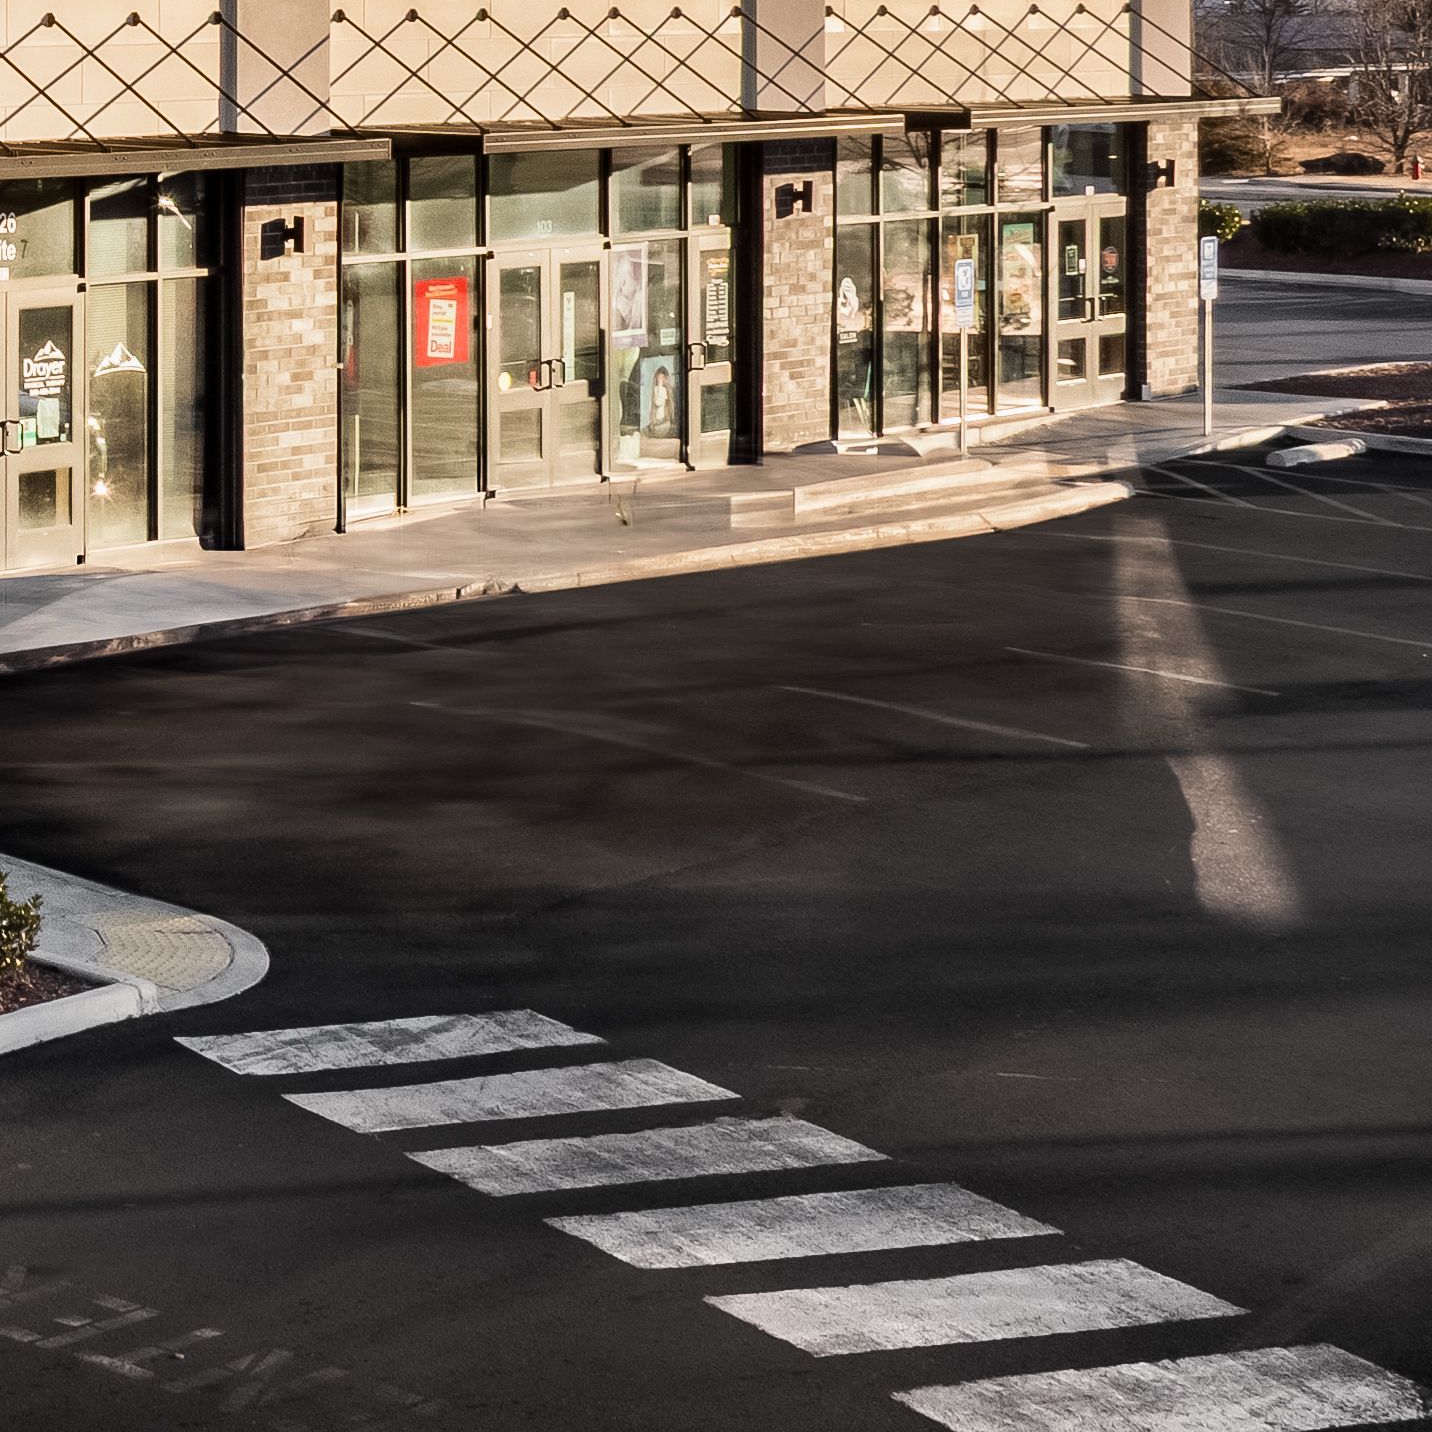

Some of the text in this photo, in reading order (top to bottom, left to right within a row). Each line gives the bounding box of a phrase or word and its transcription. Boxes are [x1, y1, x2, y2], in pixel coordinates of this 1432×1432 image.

[536, 219, 553, 234] 103
[431, 340, 452, 354] Deal
[23, 358, 66, 379] Drayer
